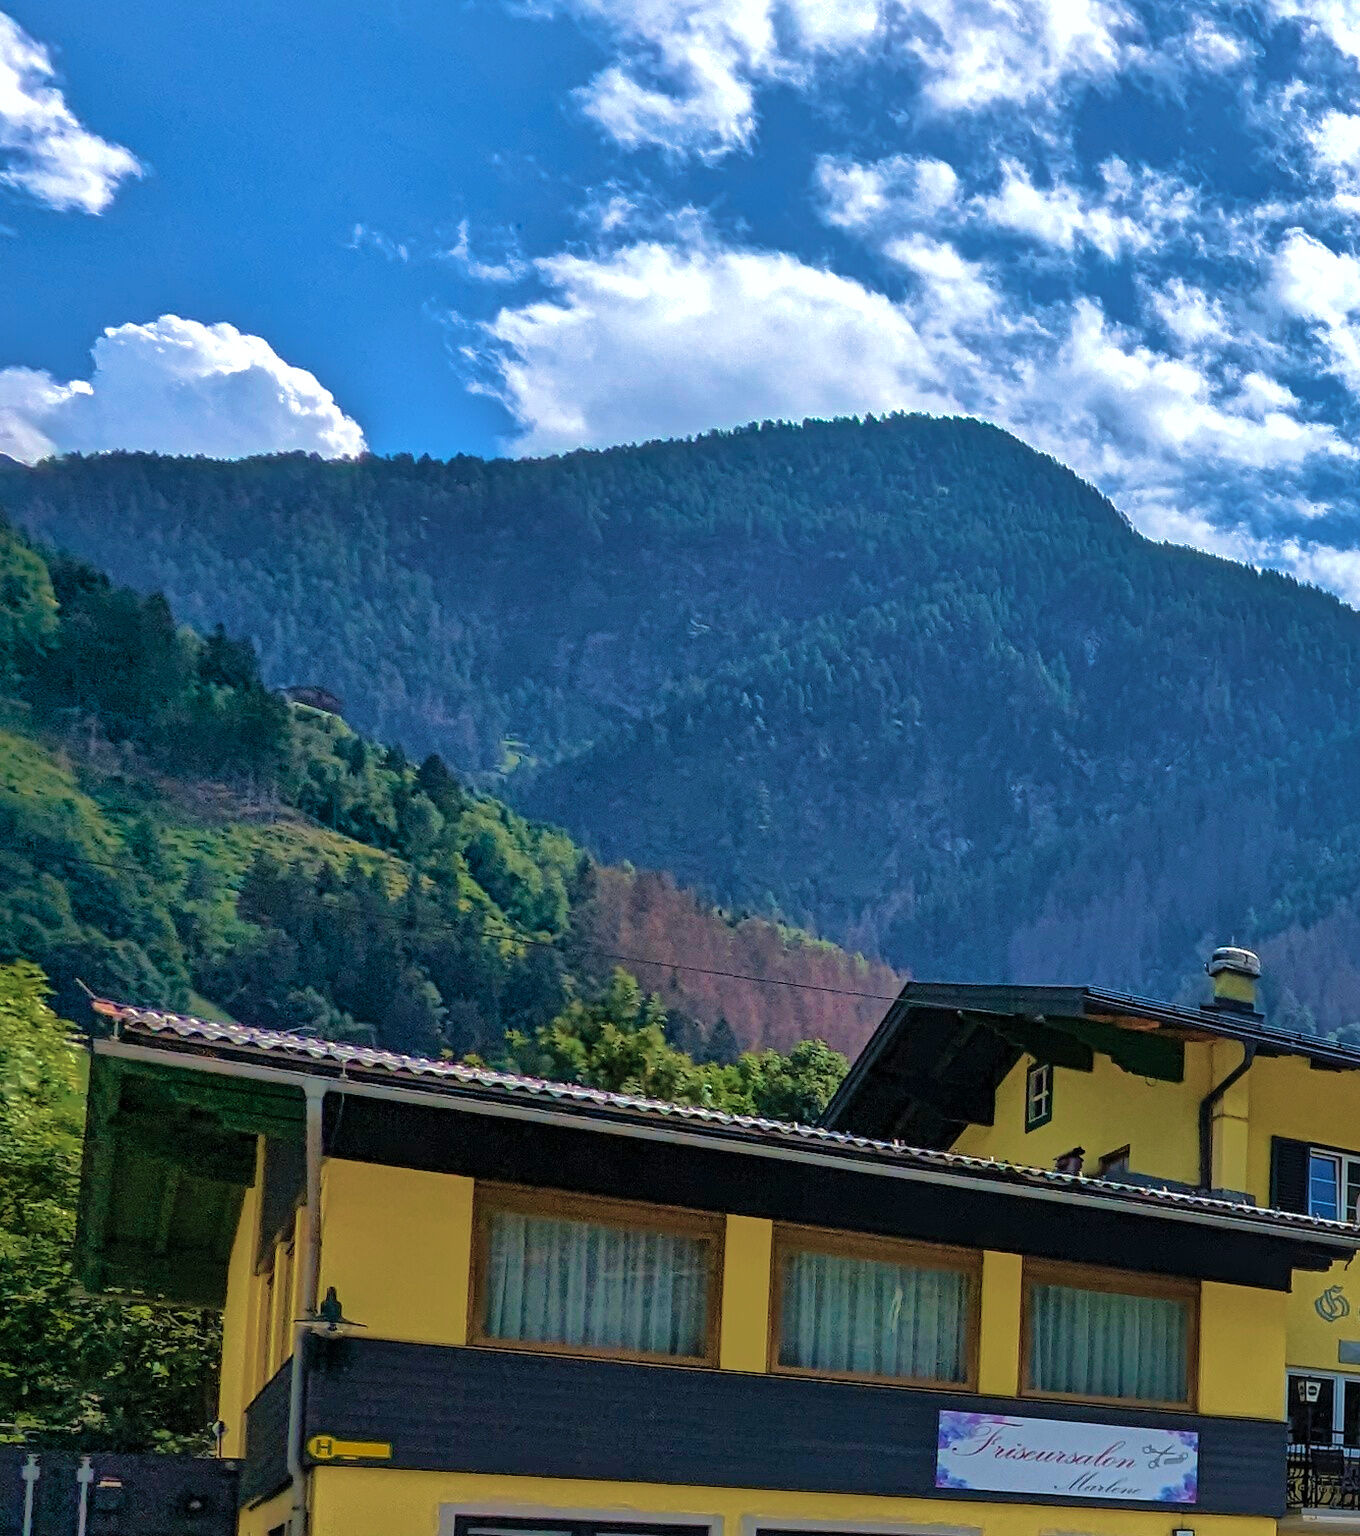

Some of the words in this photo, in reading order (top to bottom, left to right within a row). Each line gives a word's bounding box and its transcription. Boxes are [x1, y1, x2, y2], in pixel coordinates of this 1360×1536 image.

[316, 1440, 333, 1455] H
[952, 1421, 1136, 1470] Friseursalon
[1053, 1471, 1142, 1495] Marlene
